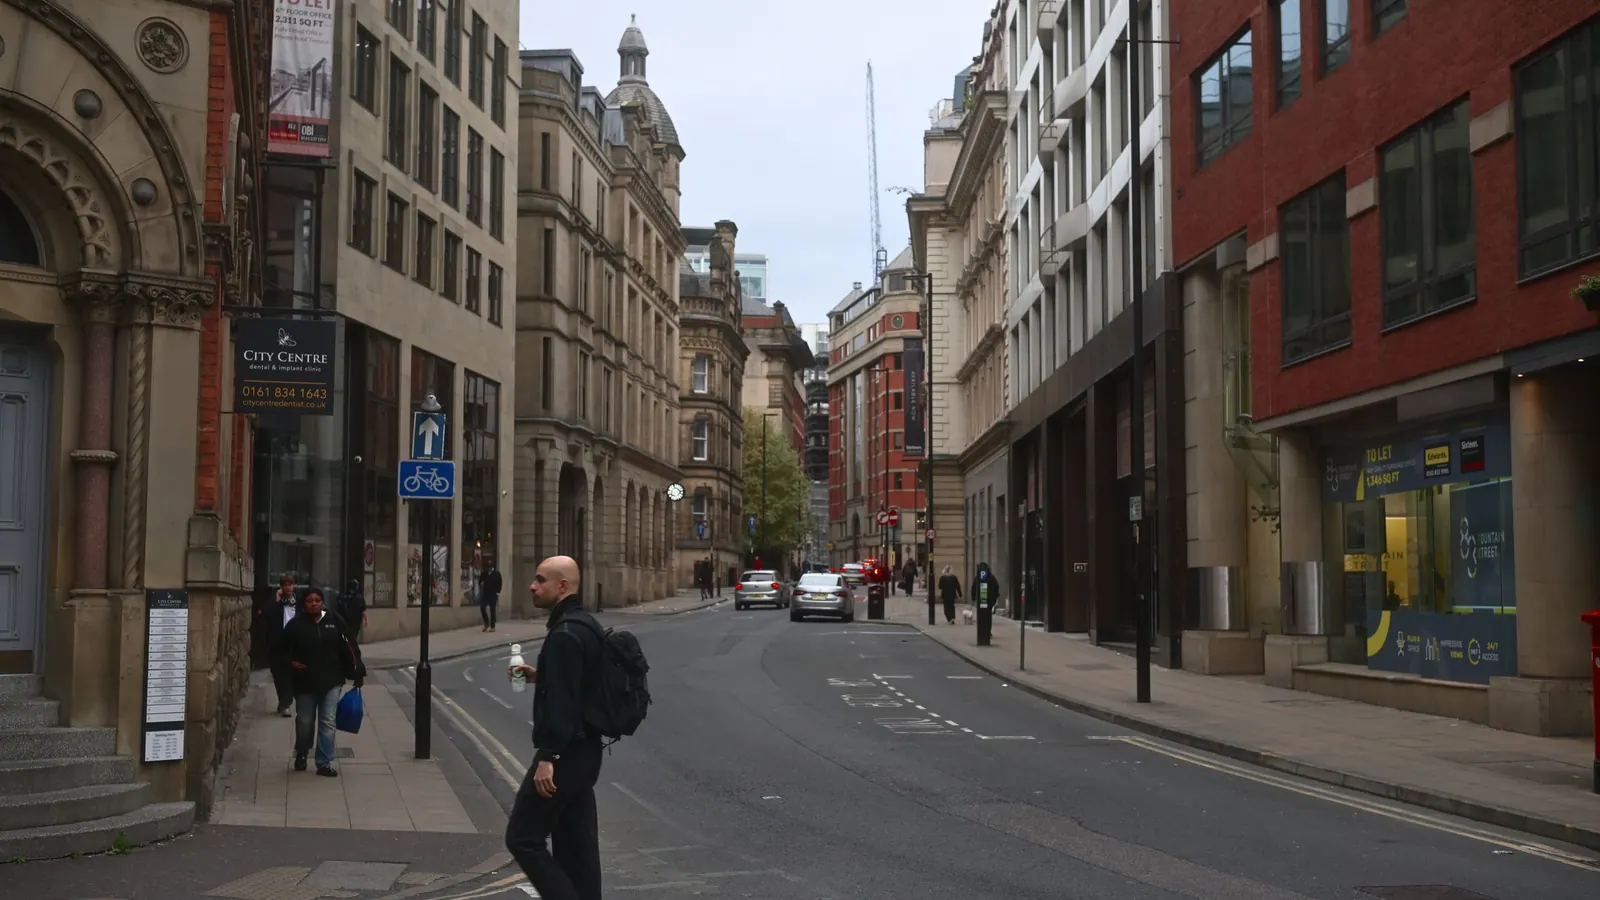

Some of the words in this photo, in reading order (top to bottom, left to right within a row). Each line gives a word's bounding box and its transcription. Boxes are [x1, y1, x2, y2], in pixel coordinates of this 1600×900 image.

[299, 18, 312, 26] SQ
[242, 386, 270, 397] 0161
[274, 388, 296, 398] 834
[300, 388, 327, 399] 1643
[242, 399, 326, 408] citycentredentist.co.uk
[1366, 448, 1377, 464] TO
[1378, 445, 1392, 461] LET
[1382, 472, 1391, 484] SQ
[1392, 471, 1400, 482] FT
[1482, 653, 1499, 661] ACCESS
